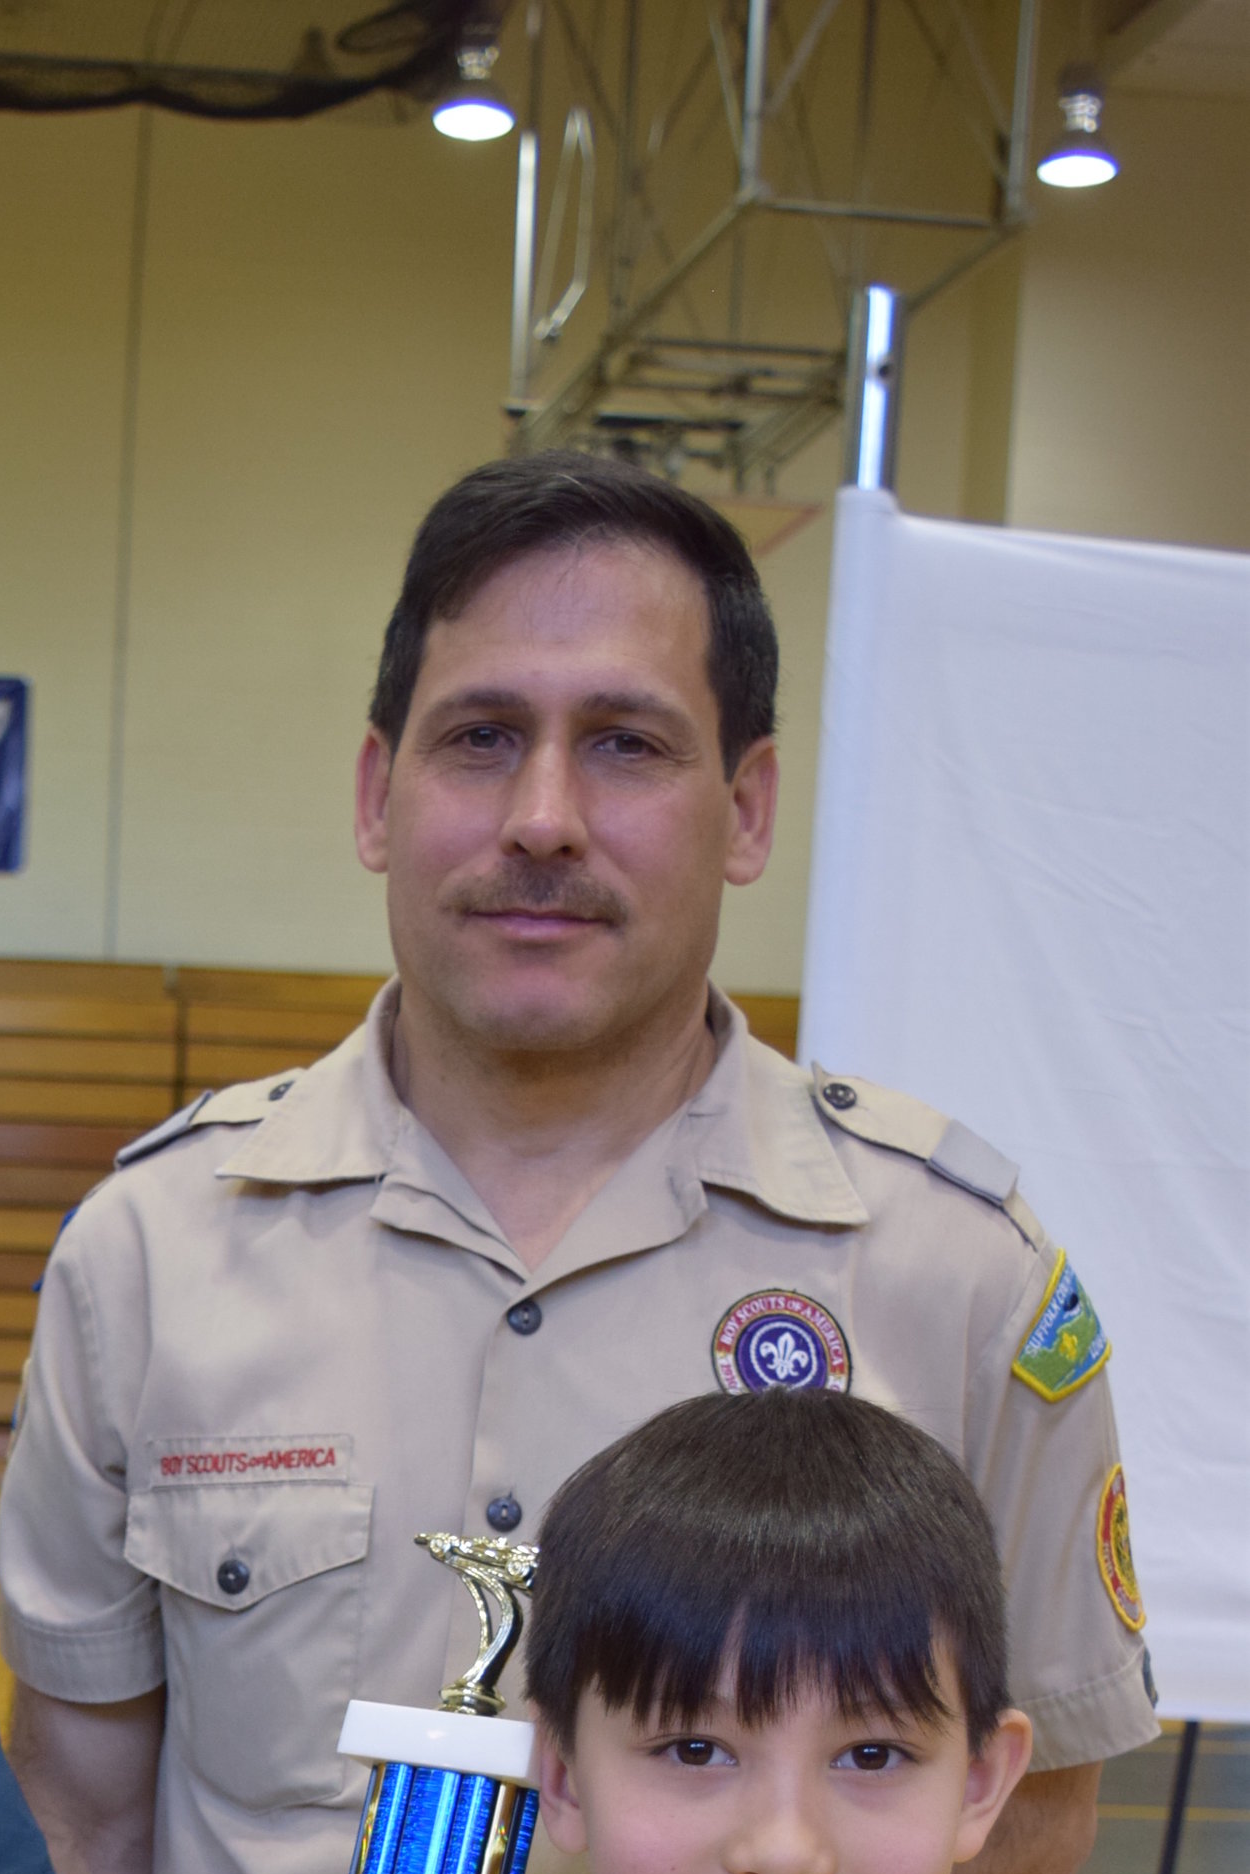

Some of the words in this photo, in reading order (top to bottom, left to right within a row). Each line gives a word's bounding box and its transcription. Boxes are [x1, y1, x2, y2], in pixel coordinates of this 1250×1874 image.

[719, 1317, 740, 1346] BOY
[738, 1296, 786, 1323] SCOUTS
[786, 1299, 802, 1311] OF
[800, 1307, 844, 1366] AMERICA
[1025, 1302, 1063, 1358] SUFFOLK
[160, 1455, 184, 1476] BOY
[185, 1452, 248, 1475] SCOUTS
[262, 1447, 335, 1470] AMERICA
